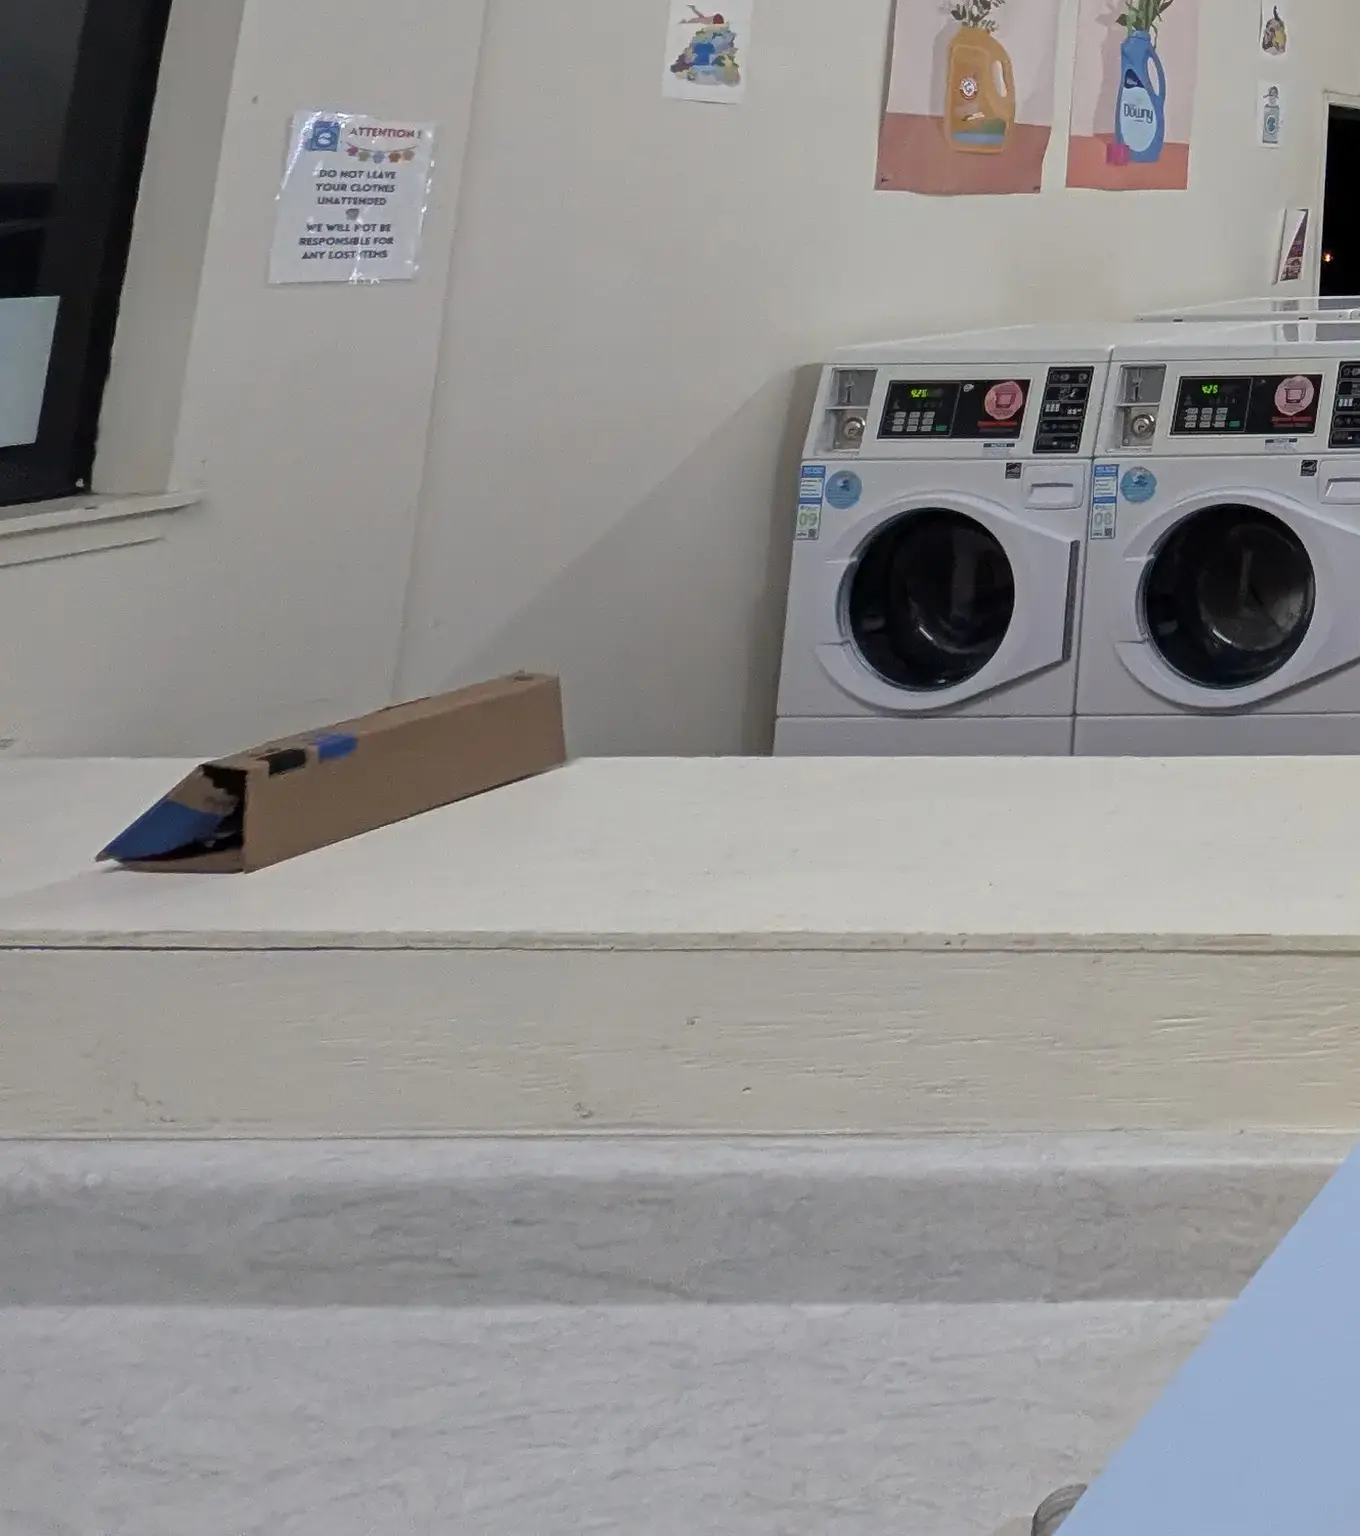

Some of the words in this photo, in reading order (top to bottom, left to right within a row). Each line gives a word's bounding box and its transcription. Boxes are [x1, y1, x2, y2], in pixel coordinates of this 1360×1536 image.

[349, 126, 415, 139] ATTENTION
[319, 169, 337, 179] DO
[340, 170, 364, 179] NOT
[367, 171, 397, 180] LEAVE
[315, 183, 348, 192] YOUR
[350, 183, 396, 193] CLOTHES
[317, 196, 387, 206] UNATTENDED
[306, 223, 322, 233] WE
[326, 223, 351, 232] WILL
[380, 223, 391, 232] BE
[298, 237, 371, 246] RESPONSIBLE
[373, 237, 394, 246] FOR
[301, 250, 326, 260] ANY
[328, 250, 357, 259] LOST
